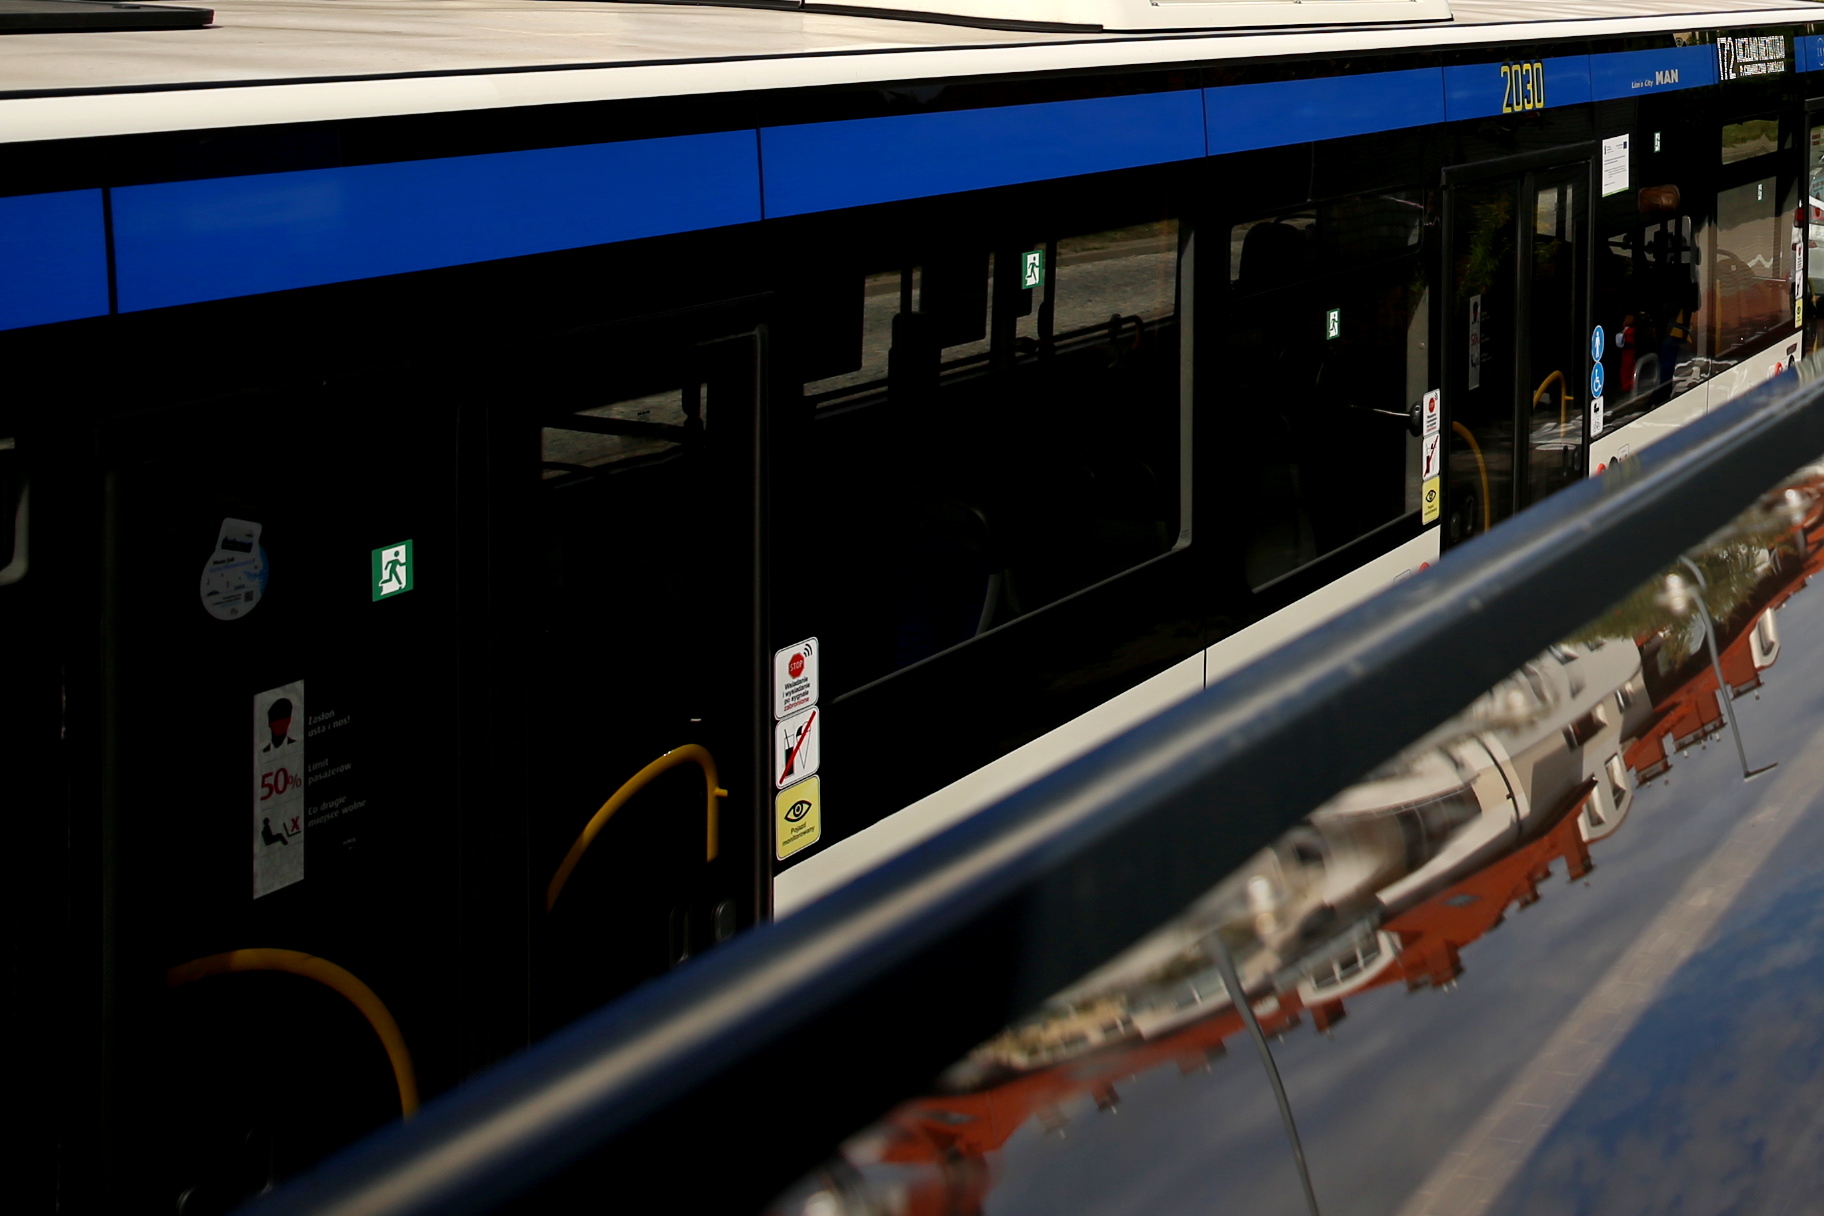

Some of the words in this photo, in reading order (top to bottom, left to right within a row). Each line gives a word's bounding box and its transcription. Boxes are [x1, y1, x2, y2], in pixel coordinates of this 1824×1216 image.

[1501, 62, 1544, 113] 2030
[1655, 69, 1679, 85] MAN
[790, 660, 803, 672] STOP
[308, 709, 335, 725] Zasłoń
[308, 725, 326, 737] usta
[333, 715, 351, 728] nos!
[308, 758, 328, 772] Limit
[260, 767, 302, 801] 50%
[308, 807, 318, 816] Co
[320, 795, 346, 811] drugie
[308, 809, 340, 828] miejsce
[342, 800, 366, 815] wolne
